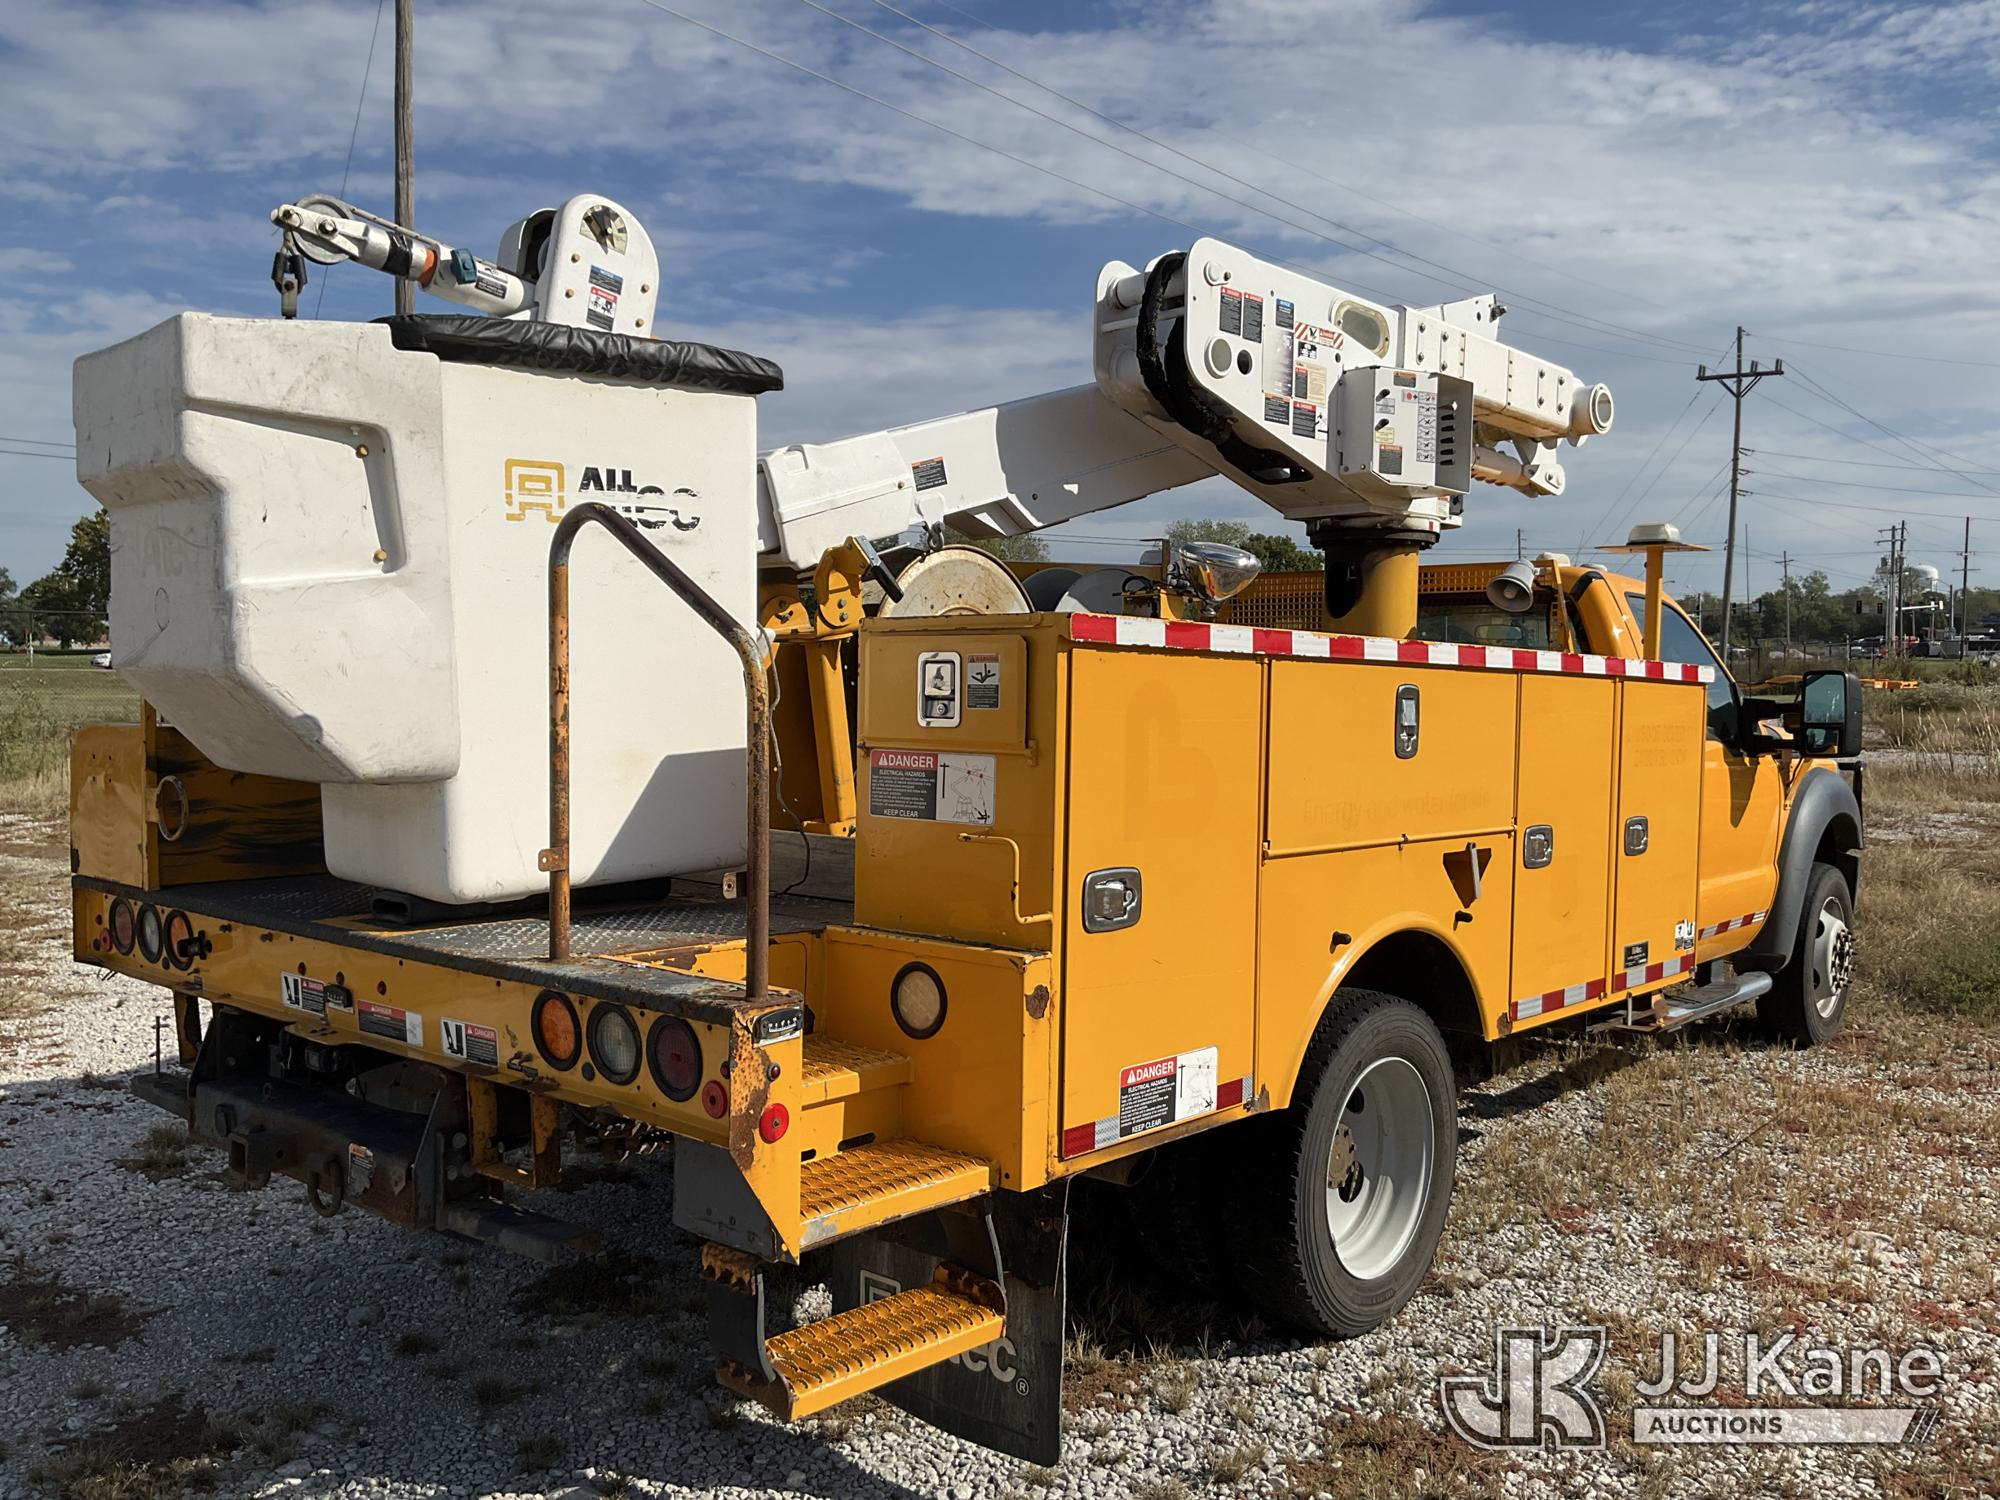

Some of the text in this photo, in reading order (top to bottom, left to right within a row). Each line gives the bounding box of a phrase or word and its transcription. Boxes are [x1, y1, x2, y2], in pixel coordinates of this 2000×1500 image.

[888, 755, 934, 768] DANGER
[883, 808, 919, 818] KEEP CLEAR
[474, 1027, 496, 1039] DANGER
[1136, 1061, 1174, 1081] DANGER
[1131, 1119, 1162, 1133] KEEP CLEAR
